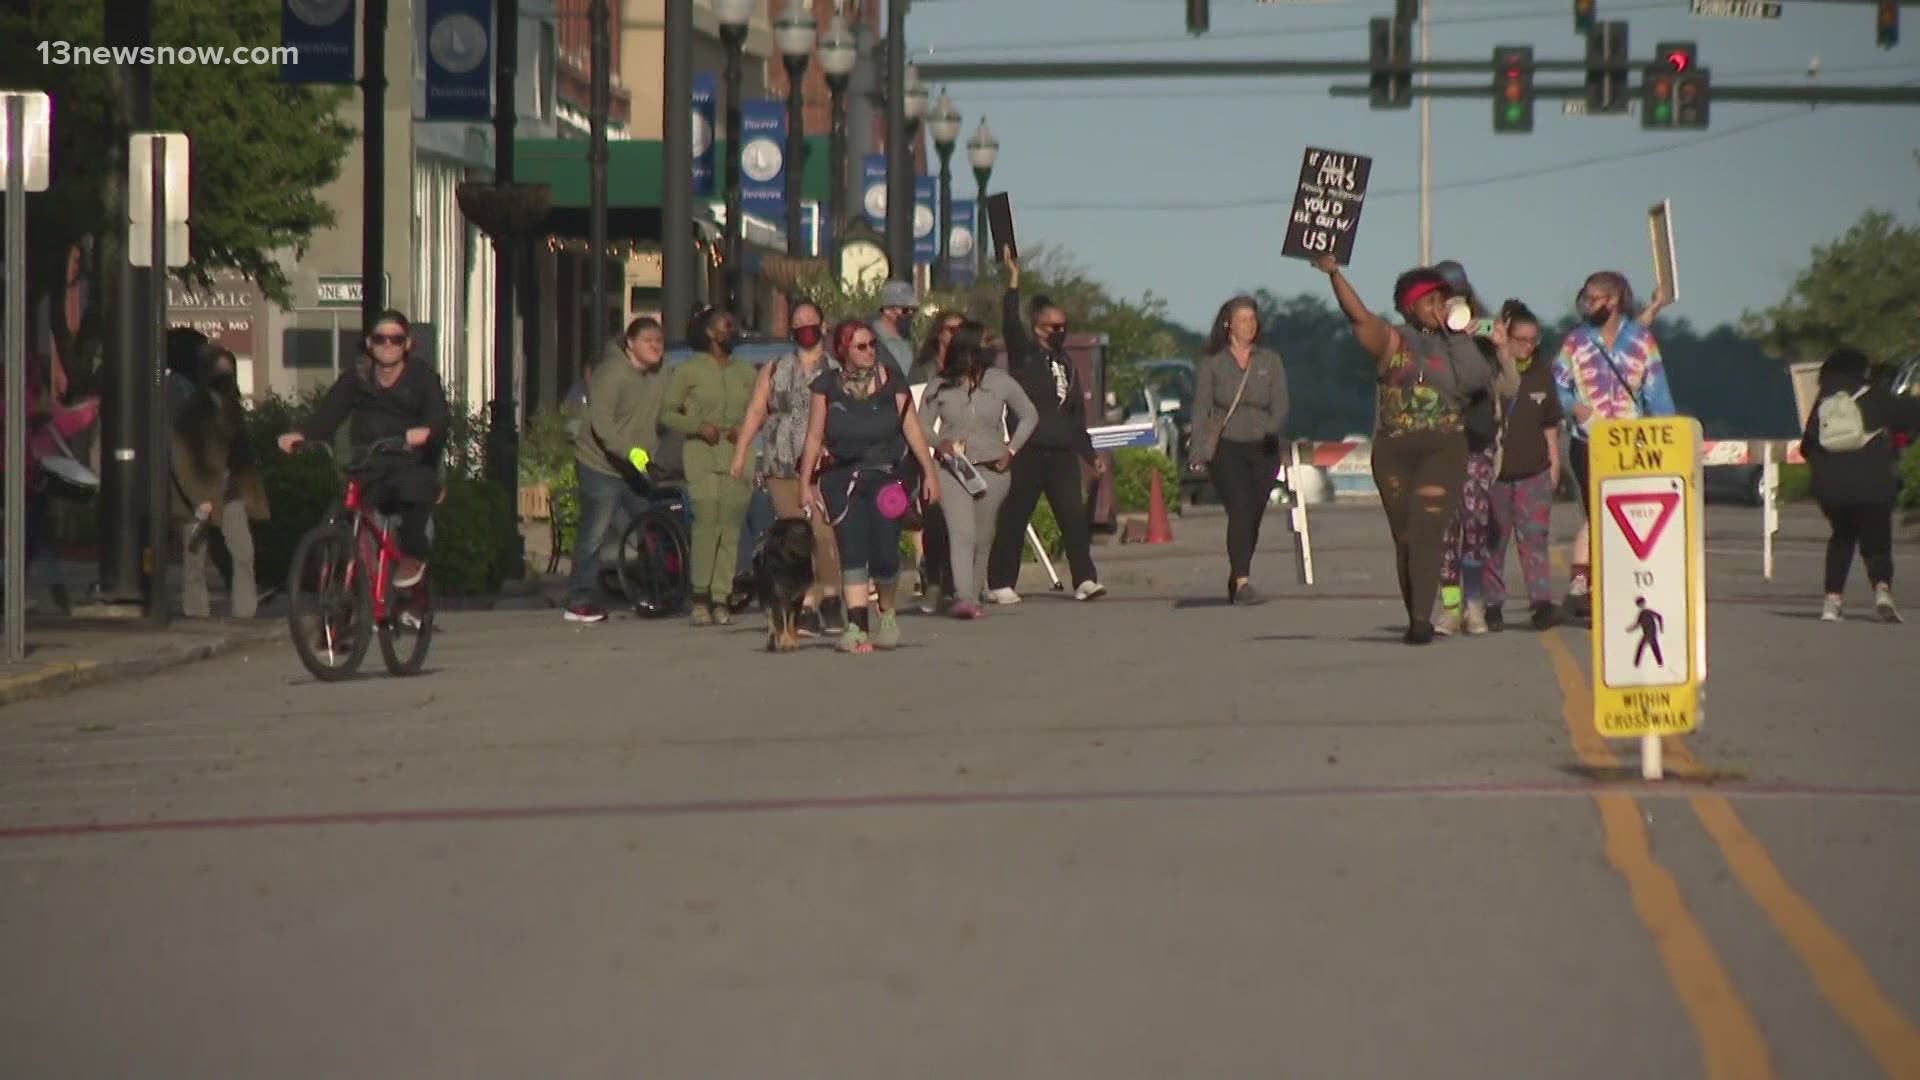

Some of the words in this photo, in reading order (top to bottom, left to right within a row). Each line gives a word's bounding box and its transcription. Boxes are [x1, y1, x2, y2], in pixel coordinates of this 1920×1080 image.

[318, 286, 341, 298] ONE
[1608, 425, 1674, 447] STATE
[1618, 448, 1663, 471] LAW
[1633, 570, 1654, 588] TO
[1622, 691, 1671, 709] WITHIN
[1604, 710, 1689, 730] CROSSWALK
